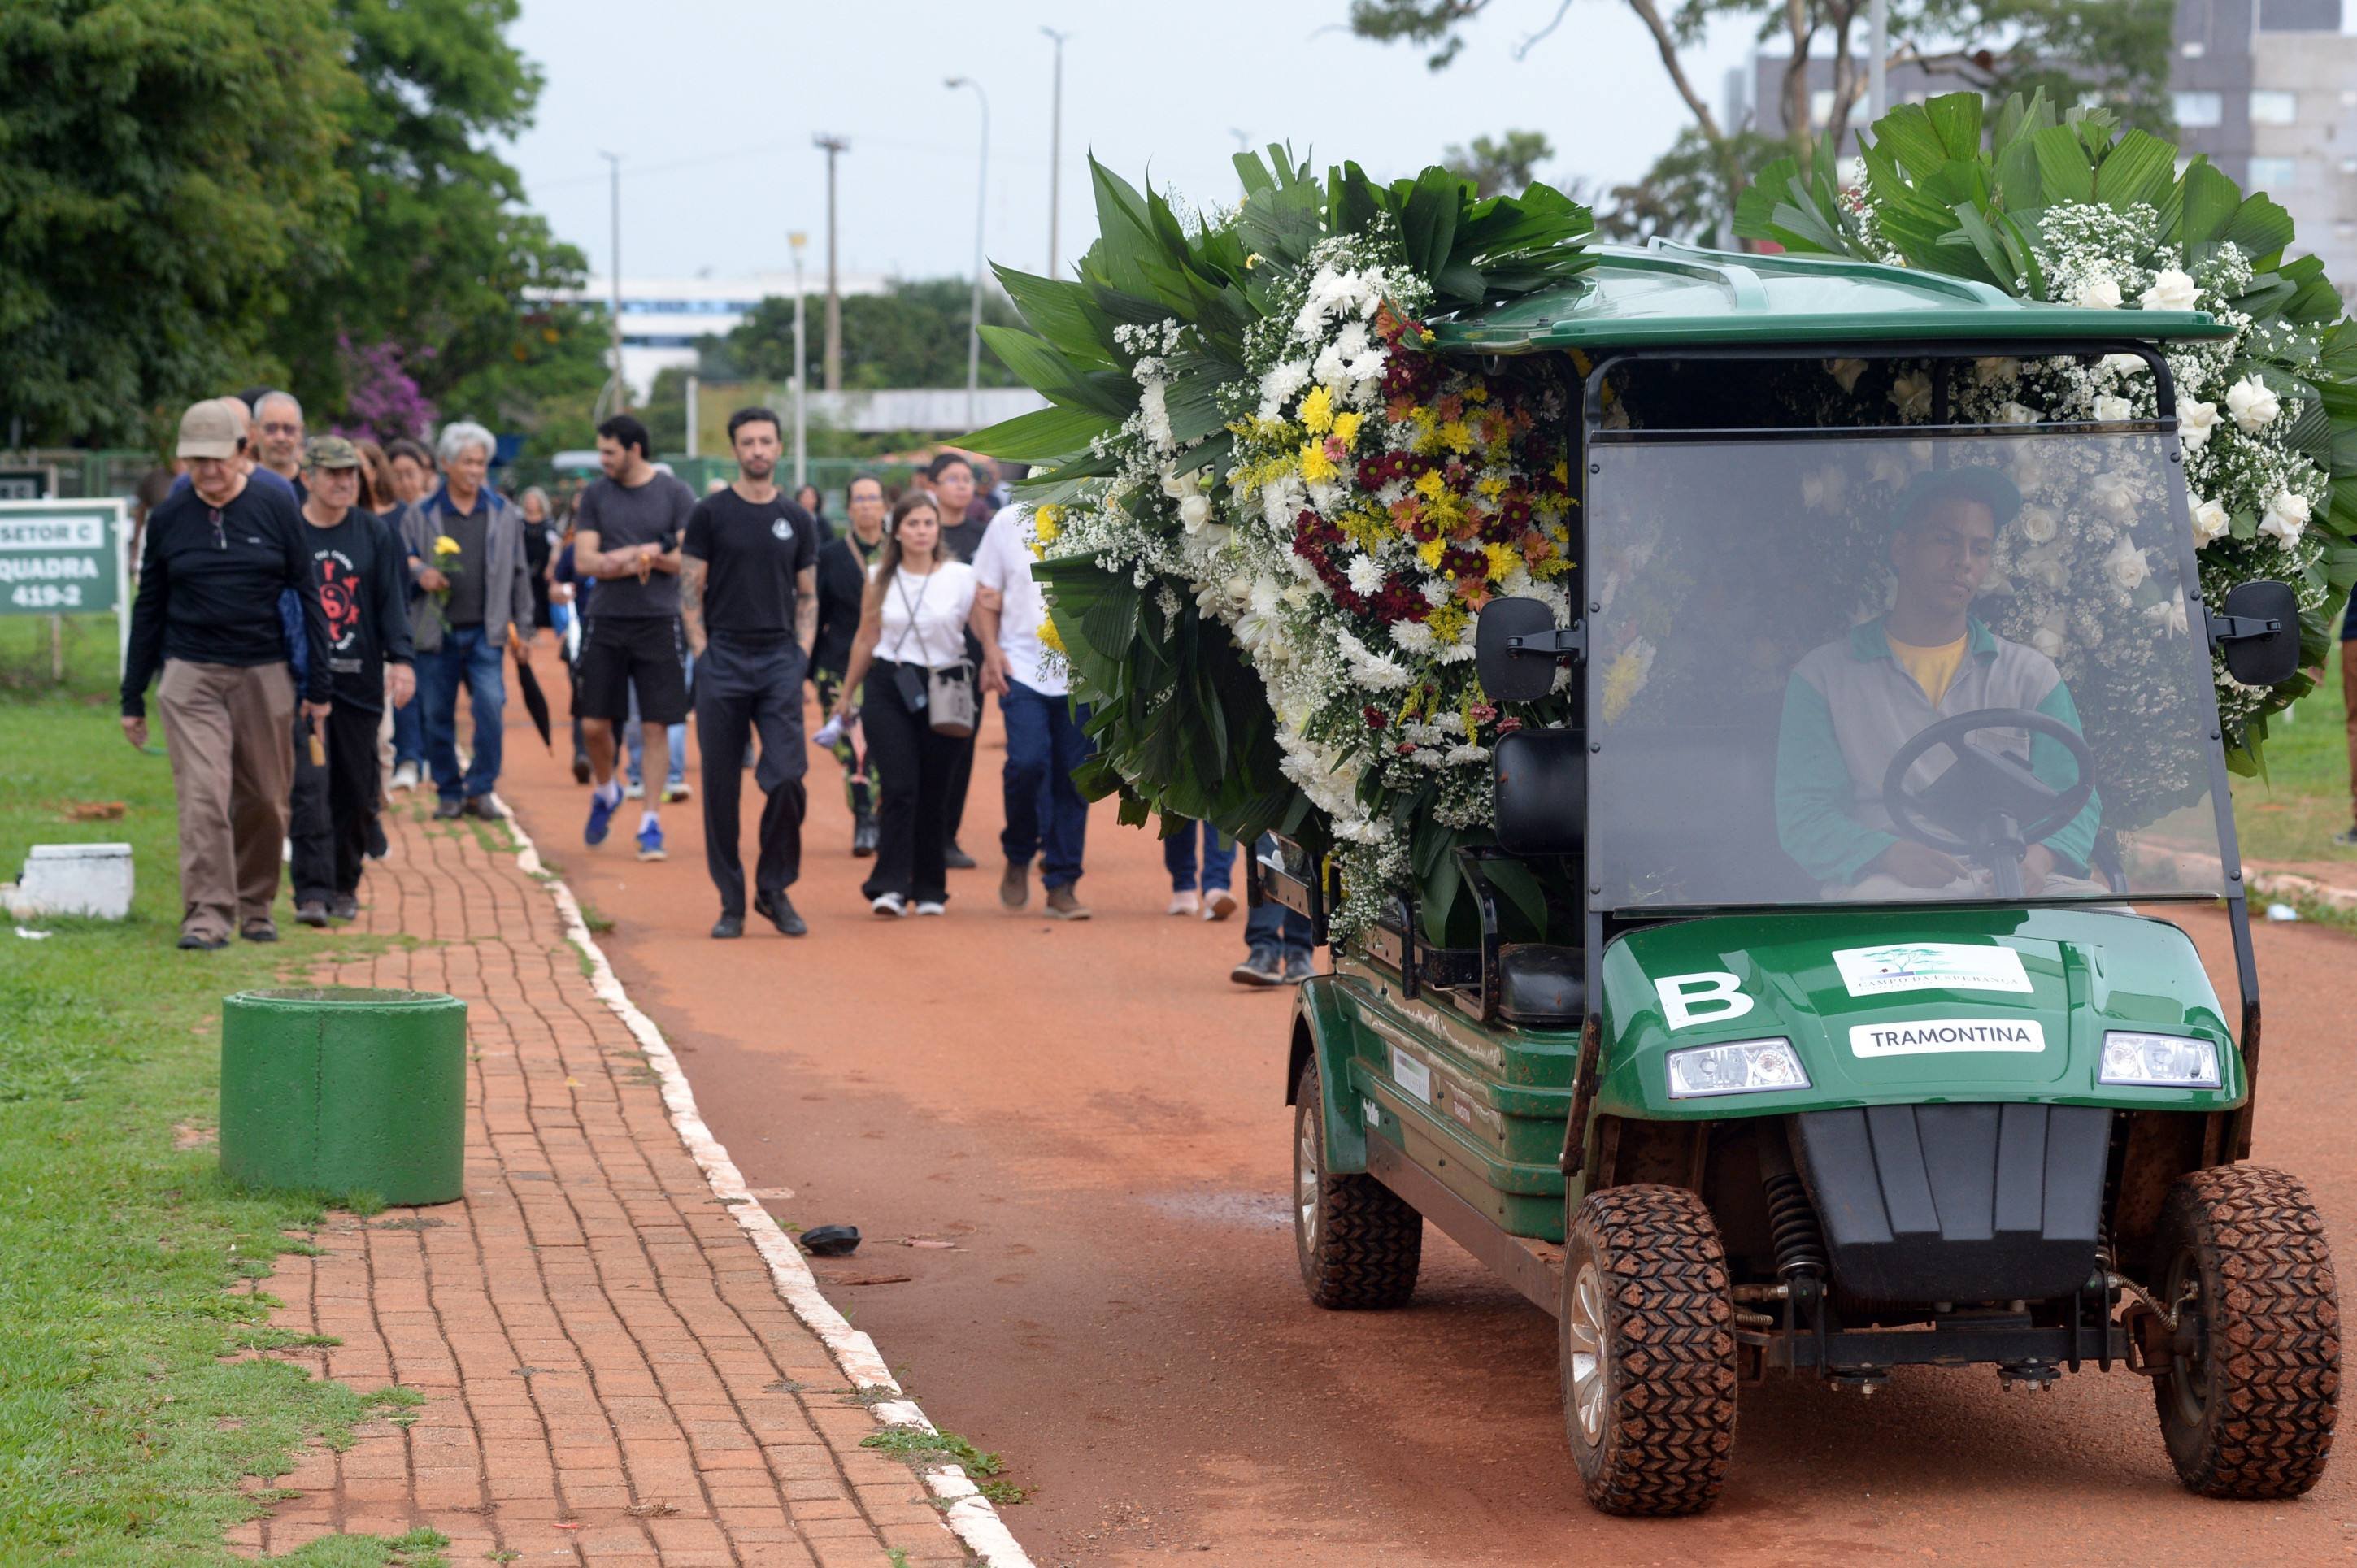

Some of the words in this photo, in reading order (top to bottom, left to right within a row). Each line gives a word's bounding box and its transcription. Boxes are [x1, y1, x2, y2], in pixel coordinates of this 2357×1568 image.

[1, 524, 69, 541] SETOR
[78, 523, 91, 540] C
[0, 557, 99, 583] QUADRA
[11, 584, 82, 606] 419-2
[1654, 971, 1755, 1032] B
[1871, 1027, 2031, 1047] TRAMONTINA
